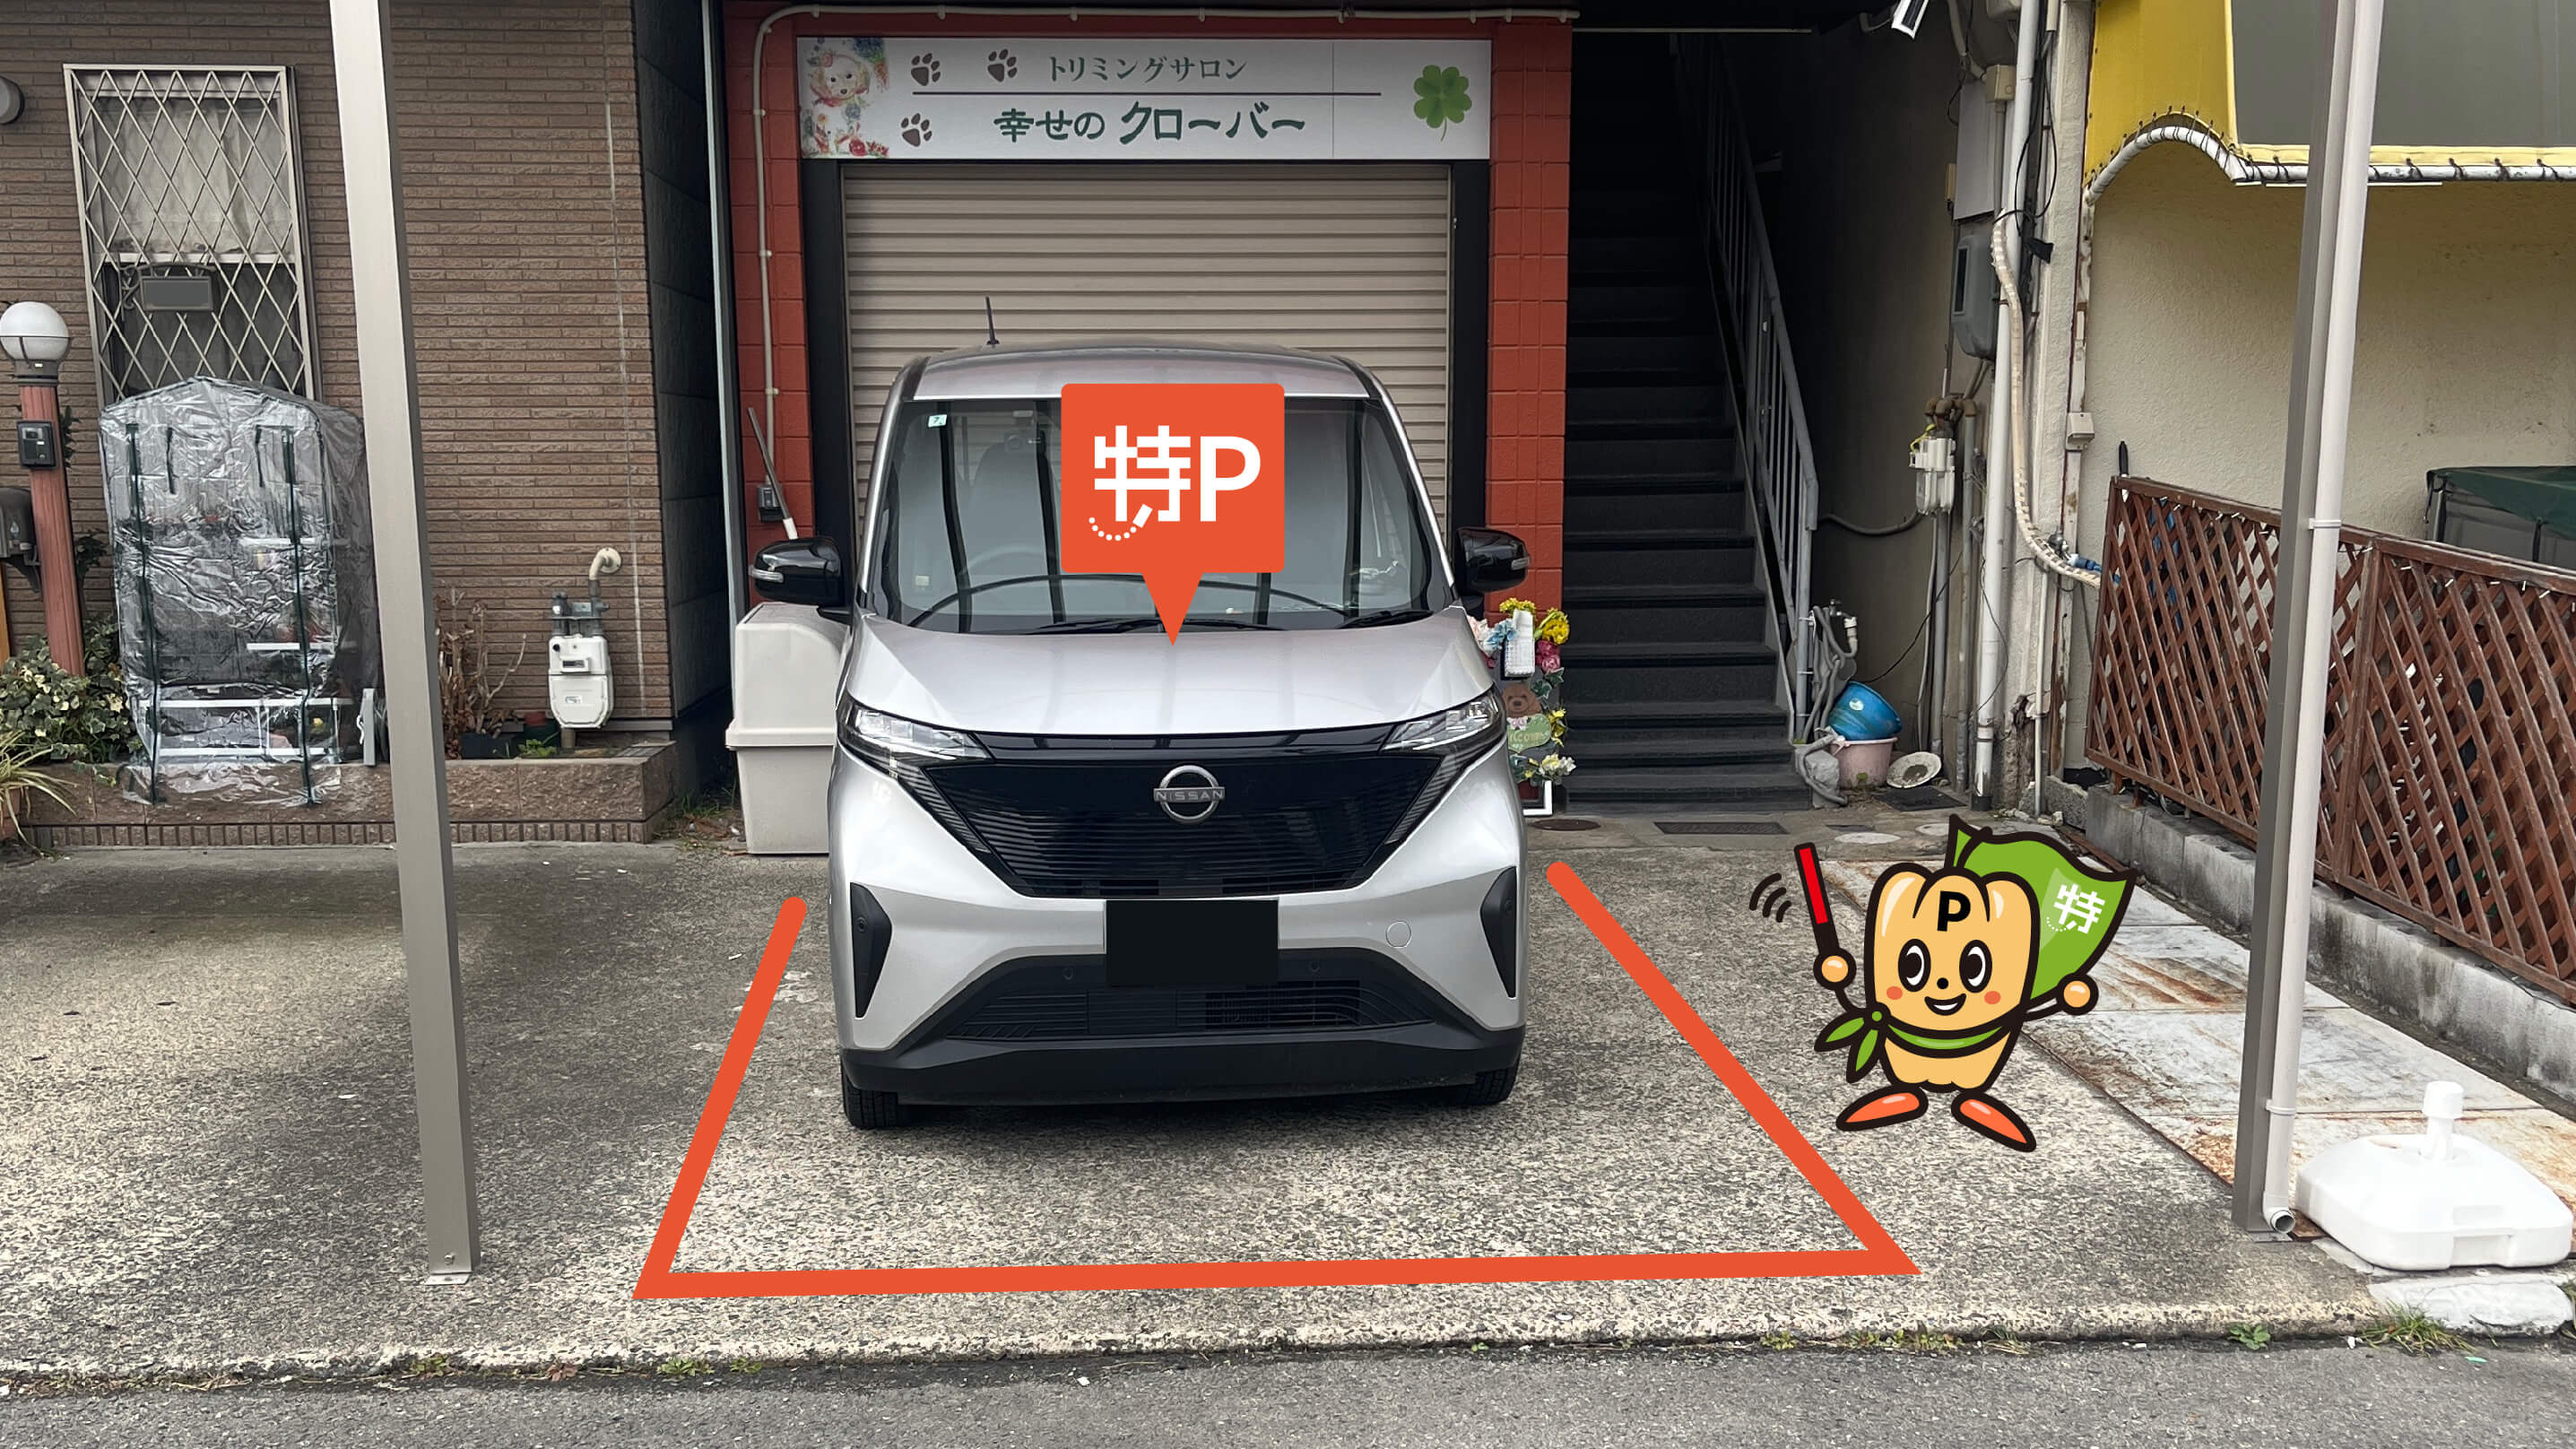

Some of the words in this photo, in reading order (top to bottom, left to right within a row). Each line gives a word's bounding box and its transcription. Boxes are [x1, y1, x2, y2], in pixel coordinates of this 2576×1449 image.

[1047, 56, 1248, 83] トリミングサロン
[1156, 790, 1223, 801] NISSAN
